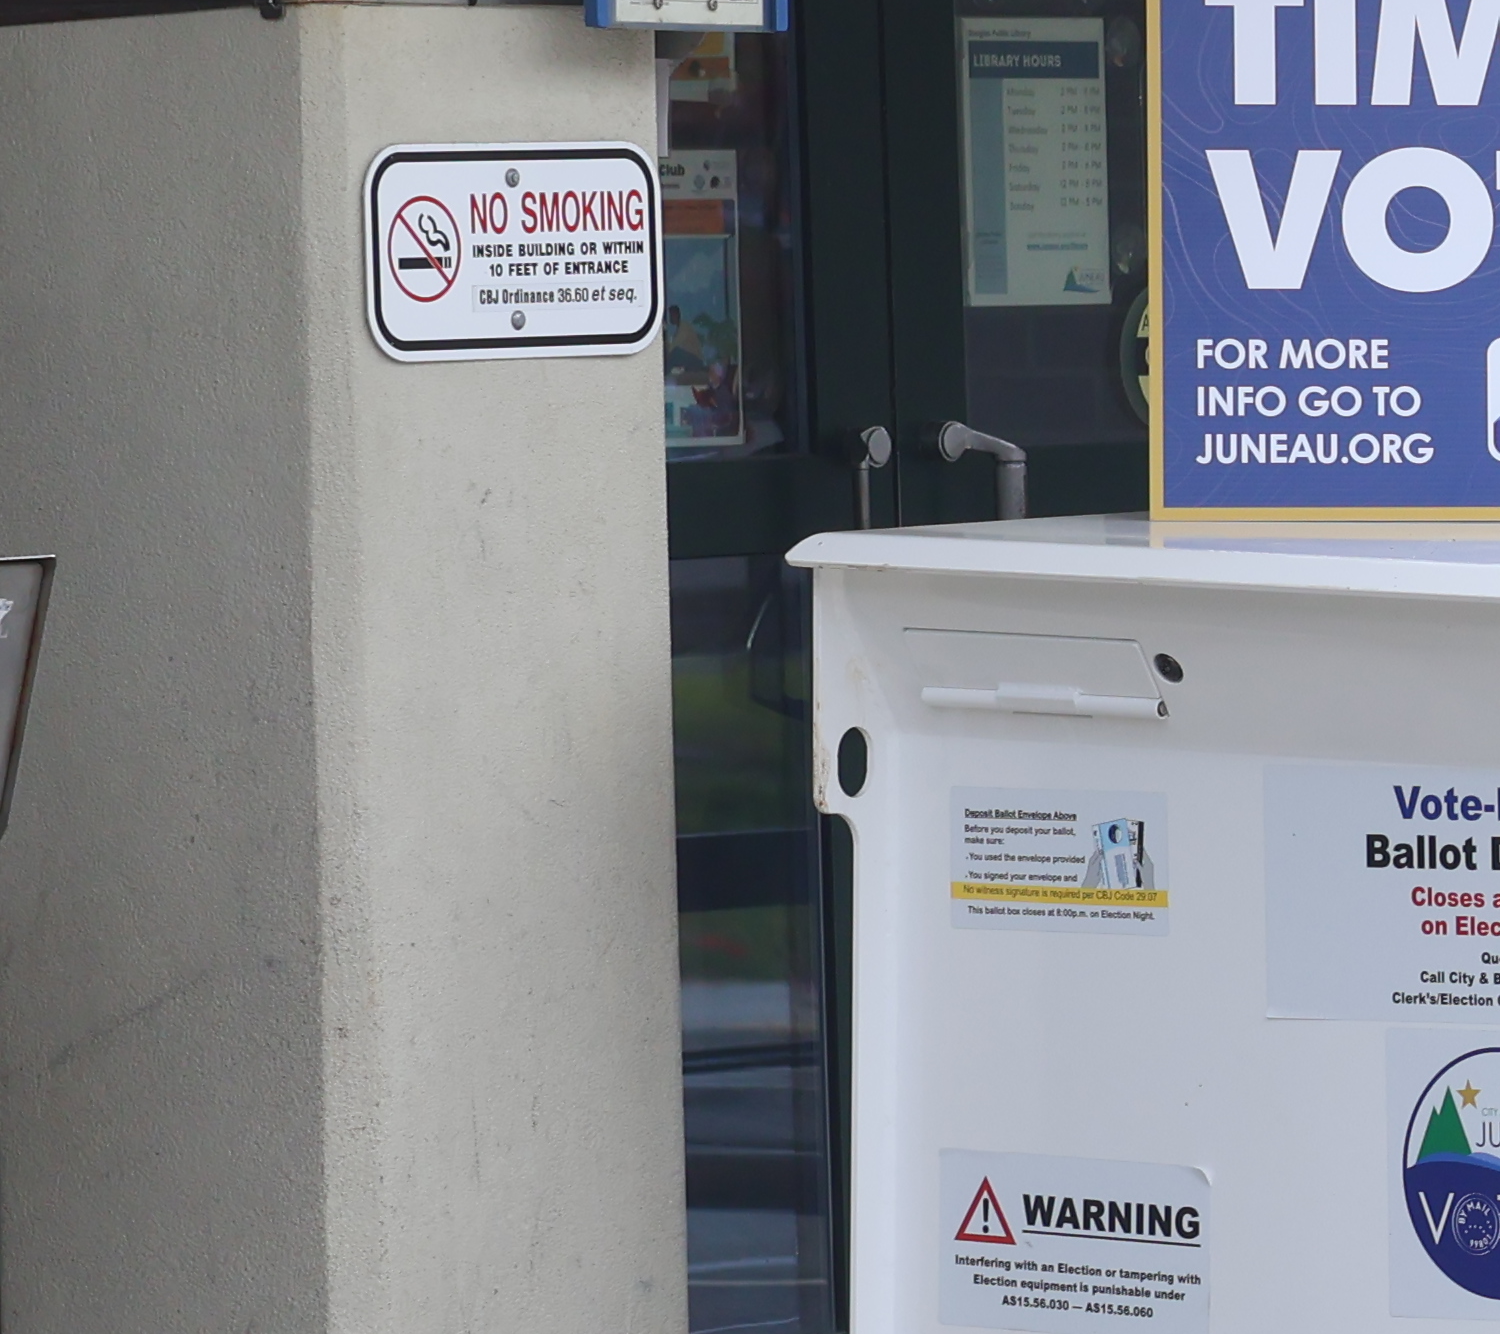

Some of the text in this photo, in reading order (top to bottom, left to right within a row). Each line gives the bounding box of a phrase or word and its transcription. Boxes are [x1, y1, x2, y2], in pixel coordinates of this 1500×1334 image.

[973, 54, 1061, 68] LIBRARY HOURS
[470, 192, 508, 234] NO
[521, 189, 644, 233] SMOKING
[472, 241, 643, 258] INSIDE BUILDING OR WITHIN
[489, 260, 629, 276] 10 FEET OF ENTRANCE
[479, 287, 637, 305] CBJ Ordinance 36.60 et seq.
[1196, 339, 1389, 369] FOR MORE
[1196, 386, 1422, 417] INFO GO TO
[1195, 433, 1434, 465] JUNEAU.ORG
[965, 808, 1077, 820] Deposit Ballot Envelope Above
[965, 824, 1076, 836] Before you deposit your ballot,
[965, 836, 1004, 845] make sure:
[969, 853, 1085, 864] You used the envelope provided
[1366, 834, 1477, 870] Ballot
[968, 871, 1077, 883] You signed your envelope and
[963, 885, 974, 894] No
[976, 885, 1003, 895] witness
[1006, 886, 1039, 898] signature
[1050, 888, 1080, 900] required
[1096, 890, 1111, 899] CBJ
[1114, 891, 1134, 900] Code
[1412, 887, 1485, 909] Closes
[1422, 918, 1447, 936] on
[1420, 971, 1445, 984] Call
[1449, 972, 1475, 988] City
[1392, 992, 1493, 1007] Clerk's/Election
[1481, 1108, 1498, 1117] CITY
[1023, 1194, 1200, 1239] WARNING
[955, 1254, 1201, 1285] Interfering with an Election or tampering with
[974, 1274, 1185, 1301] Election equipment is punishable under
[1002, 1295, 1153, 1318] AS15.56.030 AS15.56.060
